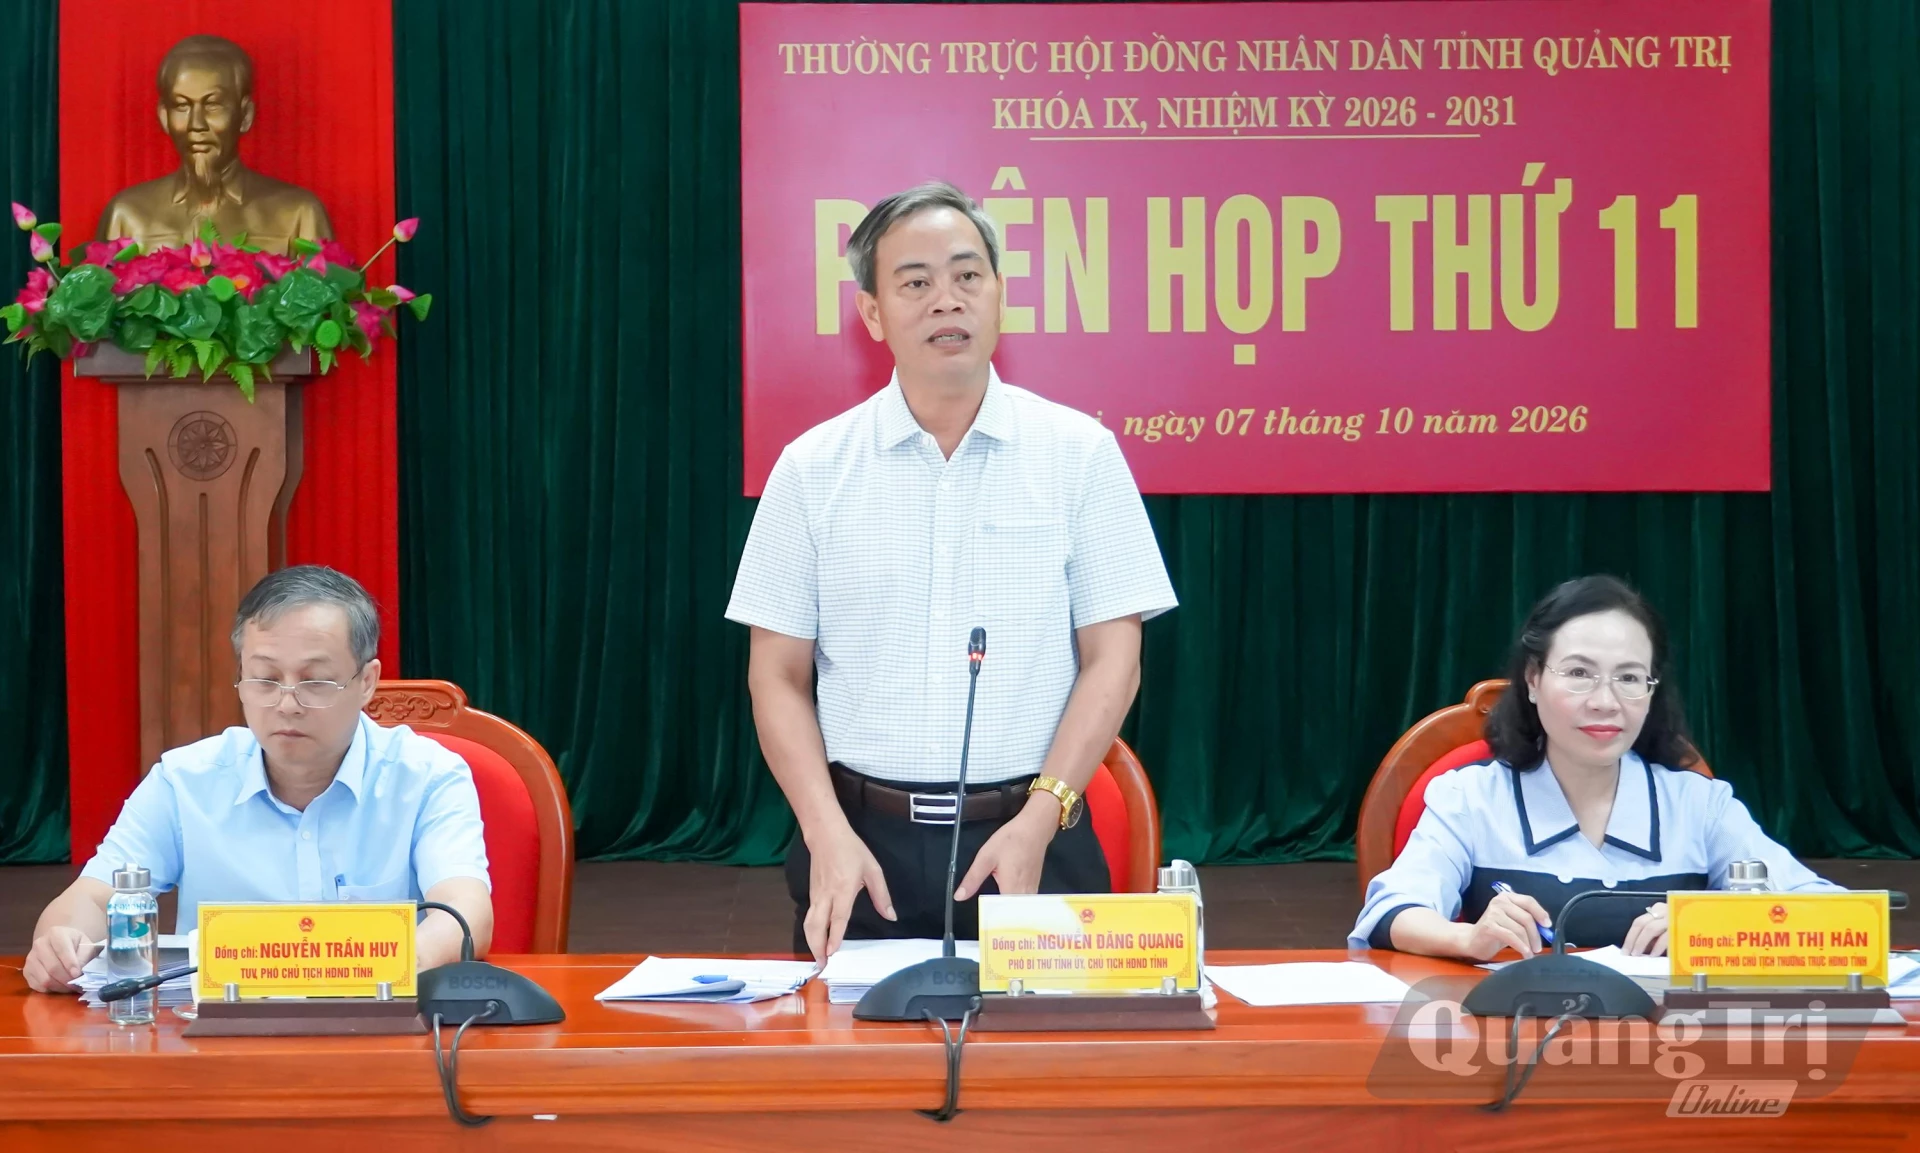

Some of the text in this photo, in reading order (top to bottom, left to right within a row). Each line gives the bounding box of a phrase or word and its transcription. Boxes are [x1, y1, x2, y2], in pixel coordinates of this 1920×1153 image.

[779, 29, 1732, 80] THƯỜNG TRỰC HỘI ĐỒNG NHÂN DÂN TỈNH QUẢNG TRỊ
[992, 90, 1094, 129] KHÓA
[1102, 98, 1147, 134] IX,
[1157, 91, 1278, 134] NHIỆM
[1288, 91, 1336, 127] KỲ
[1344, 96, 1416, 127] 2026
[1446, 95, 1517, 126] 2031
[815, 162, 1698, 365] PÊN HỌP THỨ 11
[1123, 411, 1205, 442] ngày
[1215, 408, 1255, 435] 07
[1264, 407, 1365, 441] tháng
[1375, 407, 1413, 434] 10
[1422, 410, 1498, 433] năm
[1508, 405, 1588, 432] 2026
[260, 937, 320, 958] NGUYỄN
[325, 937, 364, 958] TRẦN
[369, 942, 398, 957] HUY
[1096, 930, 1133, 949] ĐĂNG
[1138, 933, 1184, 950] QUANG
[1737, 931, 1790, 951] PHẠM
[1797, 931, 1824, 951] THỊ
[1829, 928, 1868, 947] HÂN
[261, 966, 279, 979] PHÓ
[282, 964, 300, 979] CHỦ
[302, 967, 322, 981] TỊCH
[353, 964, 373, 978] TỈNH
[1008, 957, 1024, 970] PHÓ
[1037, 957, 1052, 969] THƯ
[1054, 955, 1072, 969] TỈNH
[1088, 955, 1104, 969] CHỦ
[1106, 958, 1123, 971] TỊCH
[1150, 955, 1168, 968] TỈNH
[448, 976, 508, 989] BOSCH
[933, 970, 979, 985] BOSC
